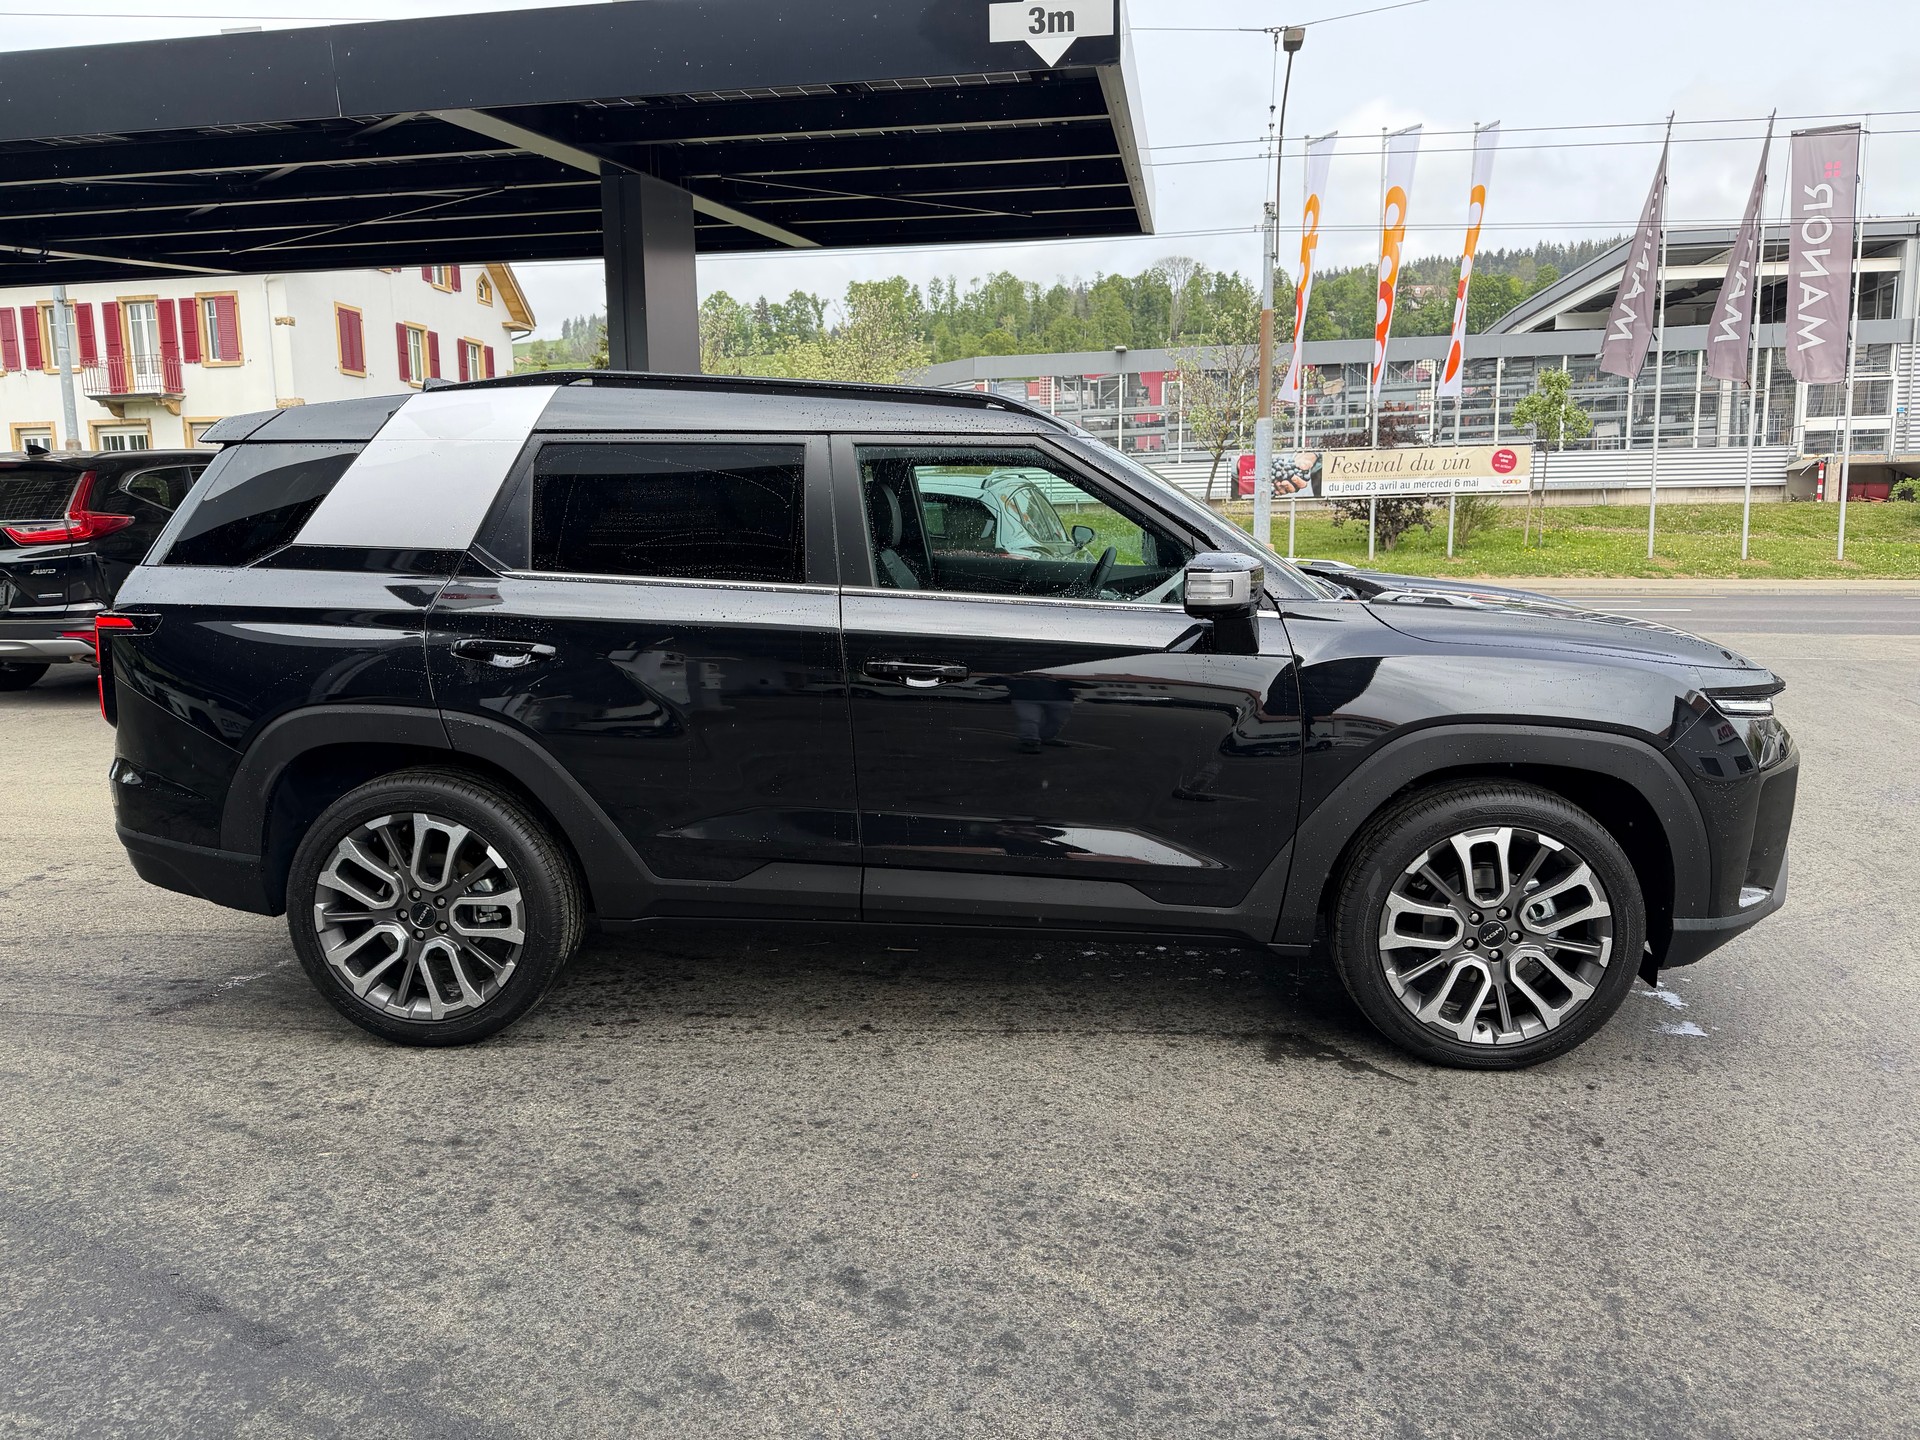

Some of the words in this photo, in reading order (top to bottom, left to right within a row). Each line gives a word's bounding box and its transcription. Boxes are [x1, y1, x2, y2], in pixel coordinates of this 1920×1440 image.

[1028, 6, 1075, 34] 3m
[1329, 453, 1403, 474] Festival
[1410, 452, 1435, 471] du
[1442, 452, 1472, 470] vin
[1328, 483, 1340, 492] du
[1341, 482, 1363, 493] jeudi
[1365, 482, 1377, 491] 23
[1379, 481, 1398, 490] avril
[1413, 479, 1452, 489] mercredi
[1454, 479, 1461, 488] 6
[1463, 478, 1479, 487] mai
[416, 906, 430, 925] KGM
[1482, 926, 1503, 942] KGM
